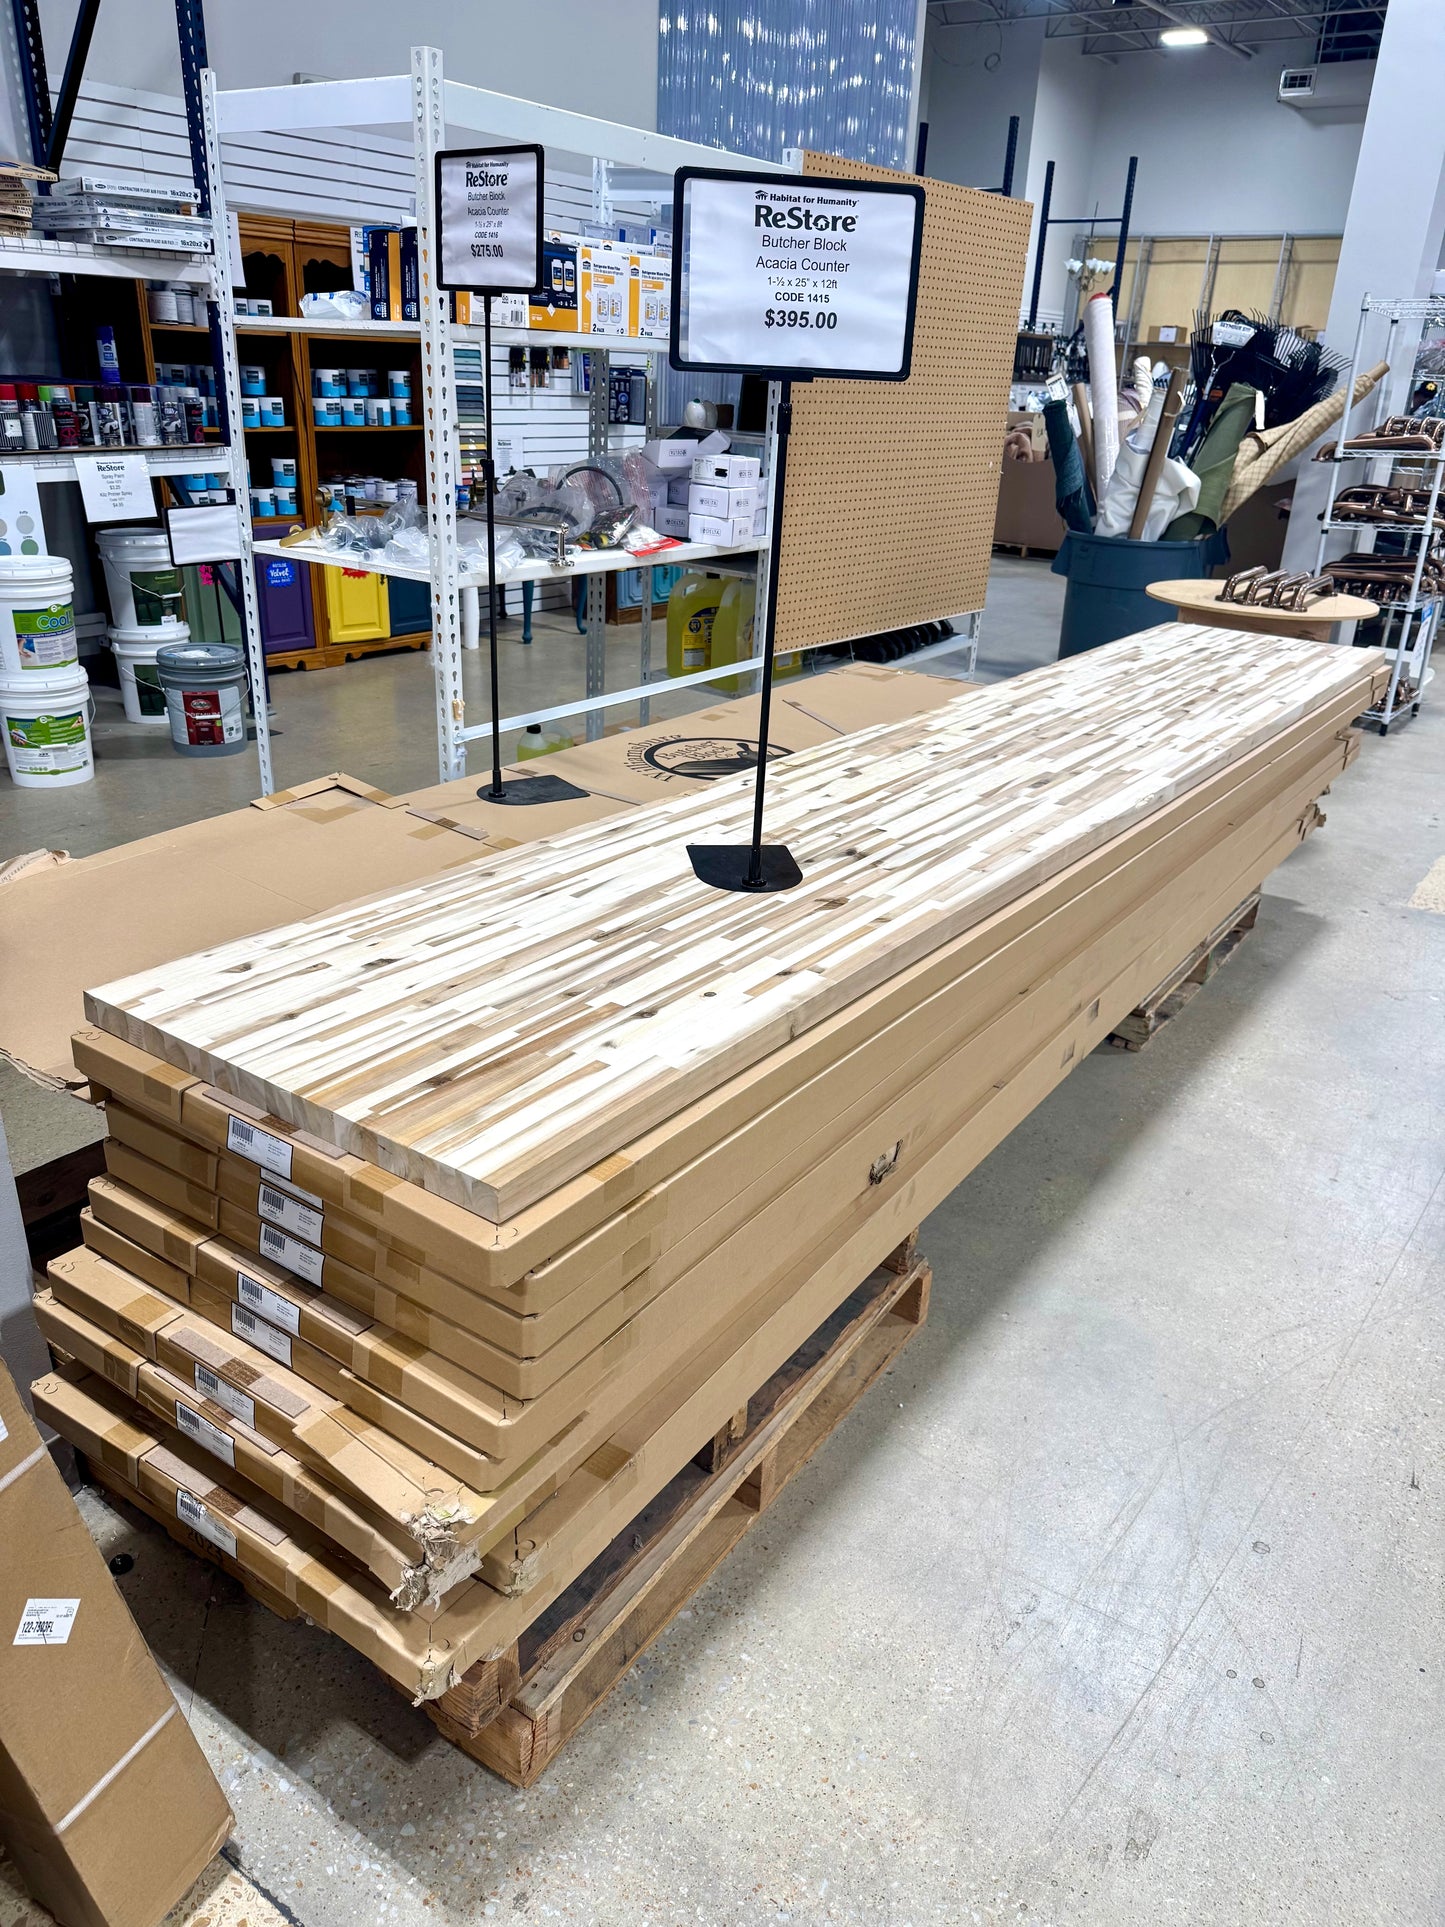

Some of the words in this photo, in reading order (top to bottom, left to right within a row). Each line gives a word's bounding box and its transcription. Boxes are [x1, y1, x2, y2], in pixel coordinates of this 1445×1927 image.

[466, 170, 508, 187] ReStore
[468, 191, 489, 201] Butcher
[489, 191, 506, 200] Block
[770, 194, 801, 203] Habitat
[803, 196, 815, 204] for
[816, 197, 858, 207] Humanity
[468, 207, 486, 216] Acacia
[487, 206, 509, 216] Counter
[754, 204, 857, 232] ReStore
[762, 234, 810, 250] Butcher
[814, 238, 847, 252] Block
[470, 244, 504, 258] $275.00
[756, 256, 797, 270] Acacia
[802, 258, 850, 272] Counter
[768, 276, 785, 287] 1-½
[795, 278, 810, 287] 25"
[821, 280, 838, 288] 12ft
[775, 292, 804, 302] CODE
[808, 294, 830, 303] 1415
[764, 308, 838, 329] $395.00
[593, 324, 597, 332] 2
[655, 740, 718, 760] Butcher
[684, 746, 734, 761] Block
